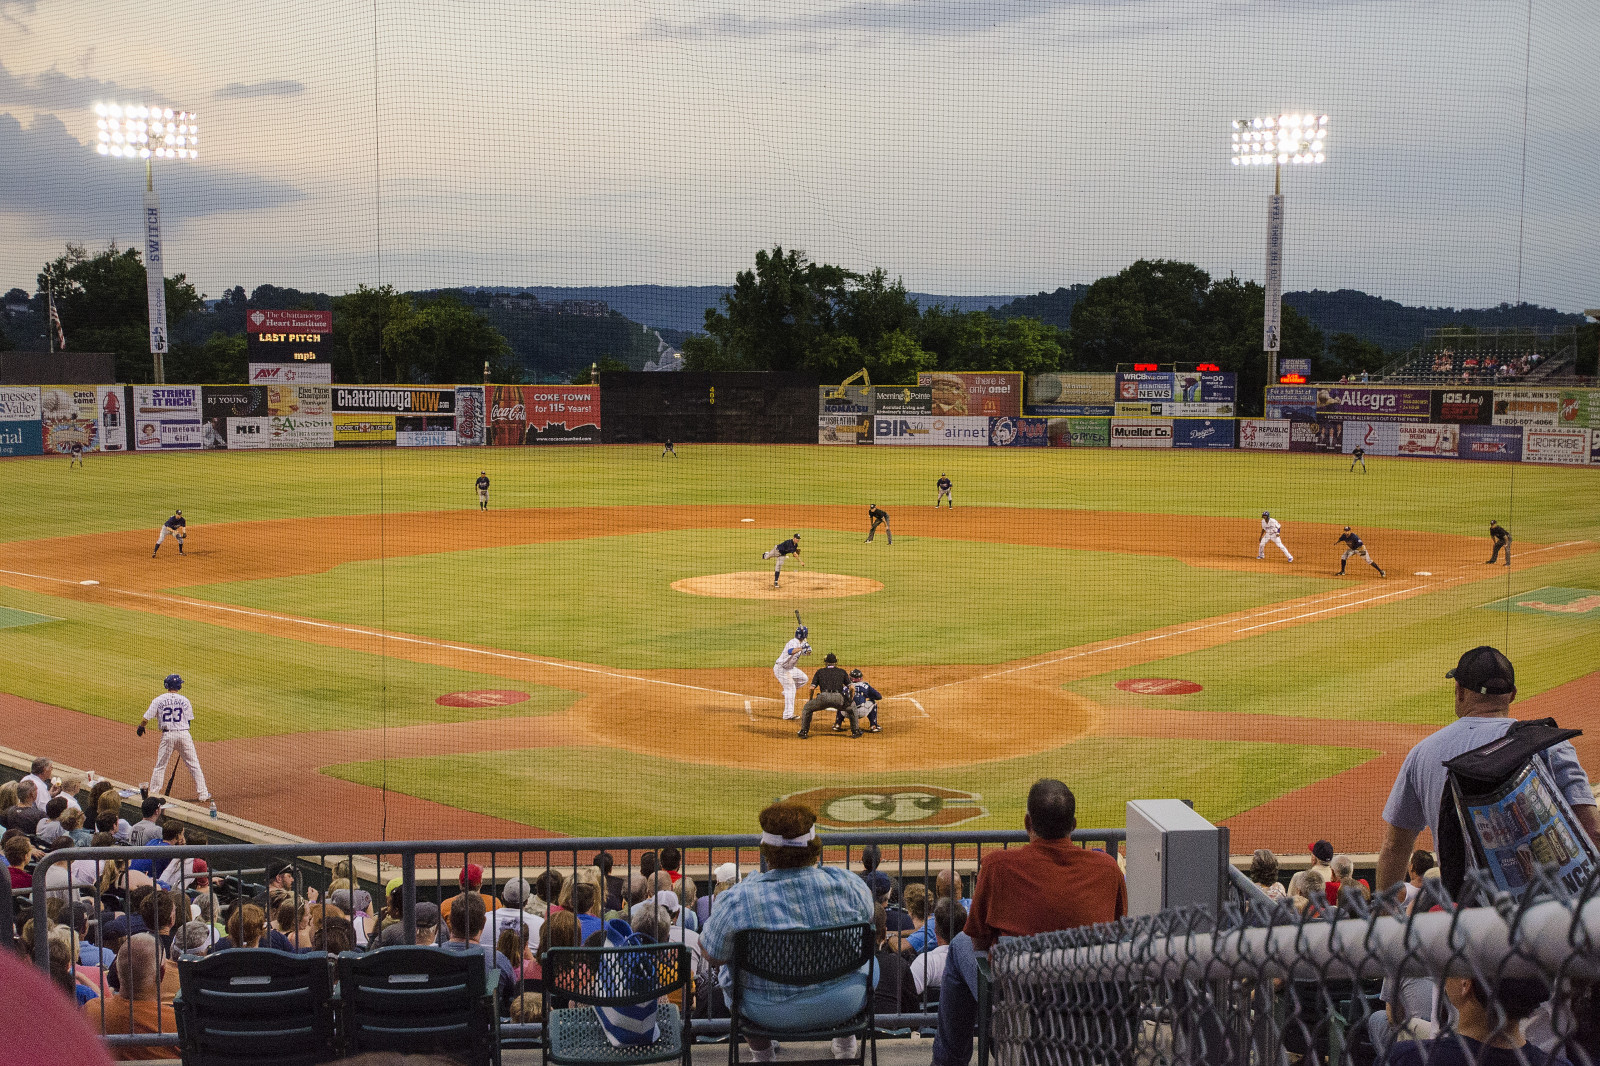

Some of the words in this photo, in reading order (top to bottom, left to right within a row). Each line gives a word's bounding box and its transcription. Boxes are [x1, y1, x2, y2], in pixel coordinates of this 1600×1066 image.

[148, 207, 160, 262] SWITCH
[280, 312, 323, 321] Chattanooga
[266, 319, 290, 327] Heart
[292, 319, 327, 328] Institute
[258, 333, 287, 342] LAST
[288, 333, 321, 343] PITCH
[293, 351, 316, 361] mph
[975, 376, 997, 384] there
[998, 376, 1006, 384] is
[969, 385, 987, 395] only
[988, 384, 1011, 394] one!
[1121, 383, 1137, 398] 3
[1138, 390, 1171, 398] NEWS
[152, 389, 196, 401] STRIKE!
[533, 393, 560, 401] COKE
[562, 393, 591, 401] TOWN
[876, 392, 904, 401] Morning
[910, 392, 931, 400] Pointe
[1442, 393, 1470, 404] 105.1
[74, 397, 96, 405] some!
[152, 398, 163, 406] IT
[164, 398, 192, 406] RICH
[207, 397, 217, 405] RJ
[1340, 390, 1396, 411] Allegra
[5, 402, 37, 417] Valley
[490, 403, 526, 422] Coca-Cola
[549, 403, 565, 412] 115
[567, 405, 592, 413] Years!
[824, 404, 868, 413] KOMATSU
[459, 397, 475, 439] Coors
[281, 417, 333, 431] Aladdin
[235, 425, 261, 434] MEI
[944, 427, 986, 438] airnet
[1114, 427, 1153, 437] Mueller
[1154, 427, 1171, 437] Co.
[1189, 426, 1216, 439] Dodgers
[415, 435, 447, 446] SPINE
[1080, 432, 1106, 443] RIVER
[162, 707, 183, 723] 23
